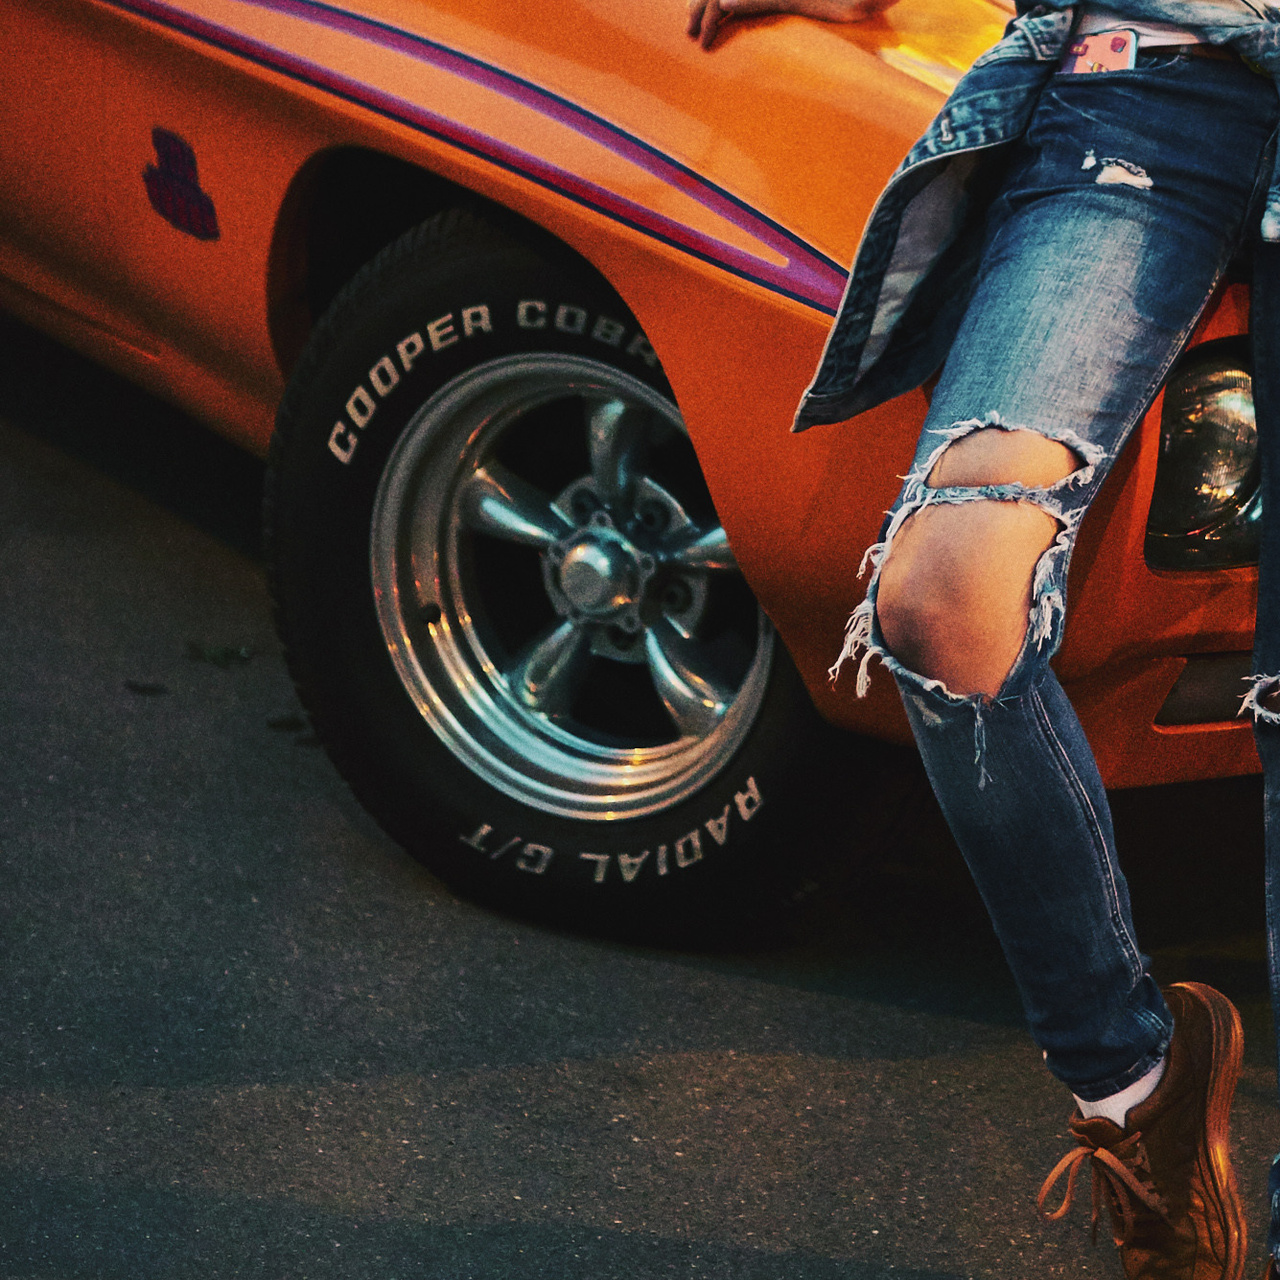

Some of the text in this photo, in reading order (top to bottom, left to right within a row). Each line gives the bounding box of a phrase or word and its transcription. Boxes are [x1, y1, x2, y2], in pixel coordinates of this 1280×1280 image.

[327, 299, 660, 465] COOPER COBR
[458, 776, 764, 883] RADIAL G/T
